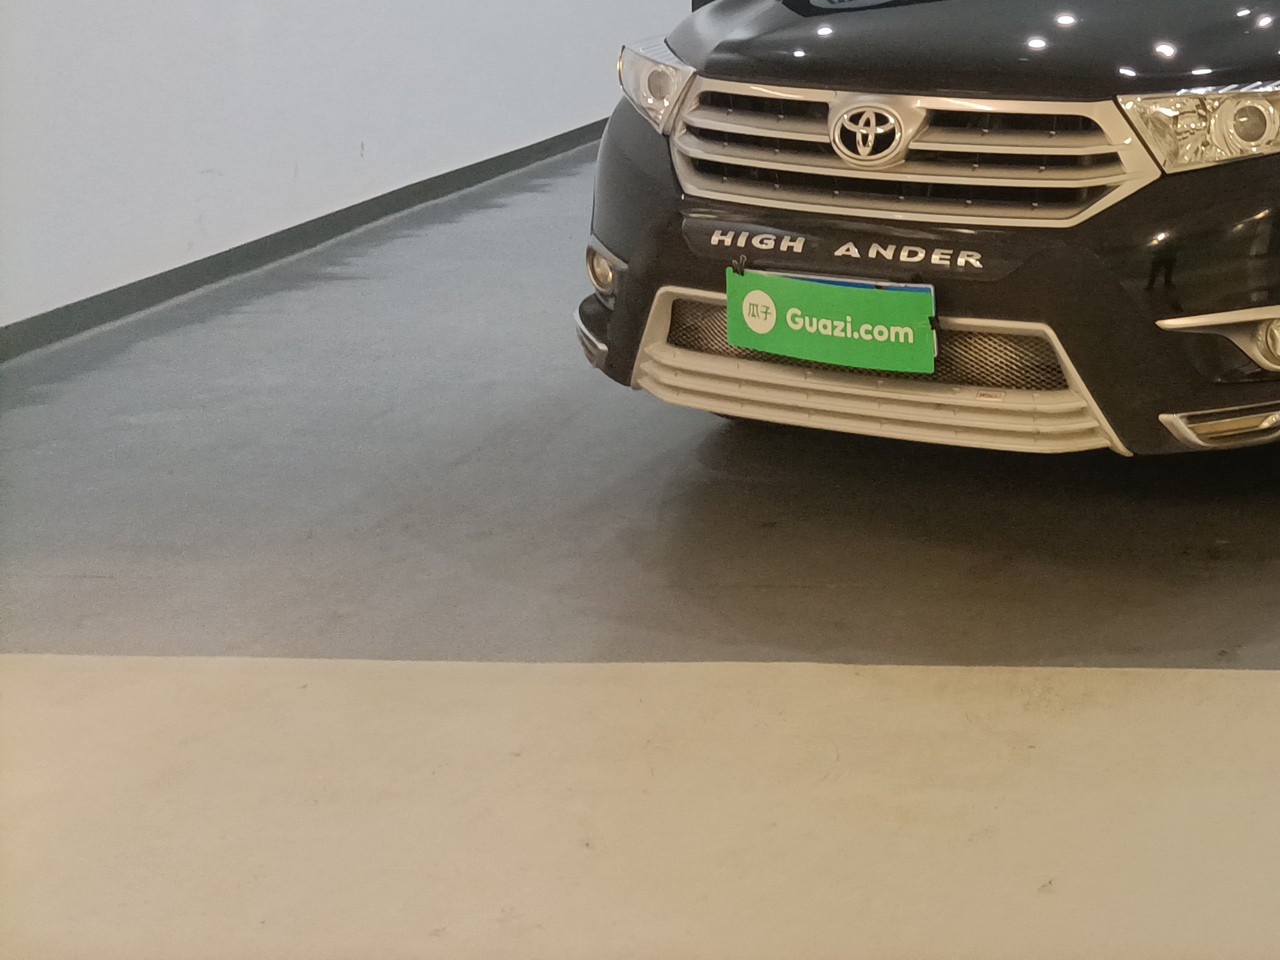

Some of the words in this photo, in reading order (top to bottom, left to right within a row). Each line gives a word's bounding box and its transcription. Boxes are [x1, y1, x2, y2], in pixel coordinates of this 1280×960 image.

[710, 229, 806, 253] HIGH
[833, 241, 984, 269] ANDER
[747, 302, 772, 321] 瓜子
[785, 307, 914, 344] Guazi.com
